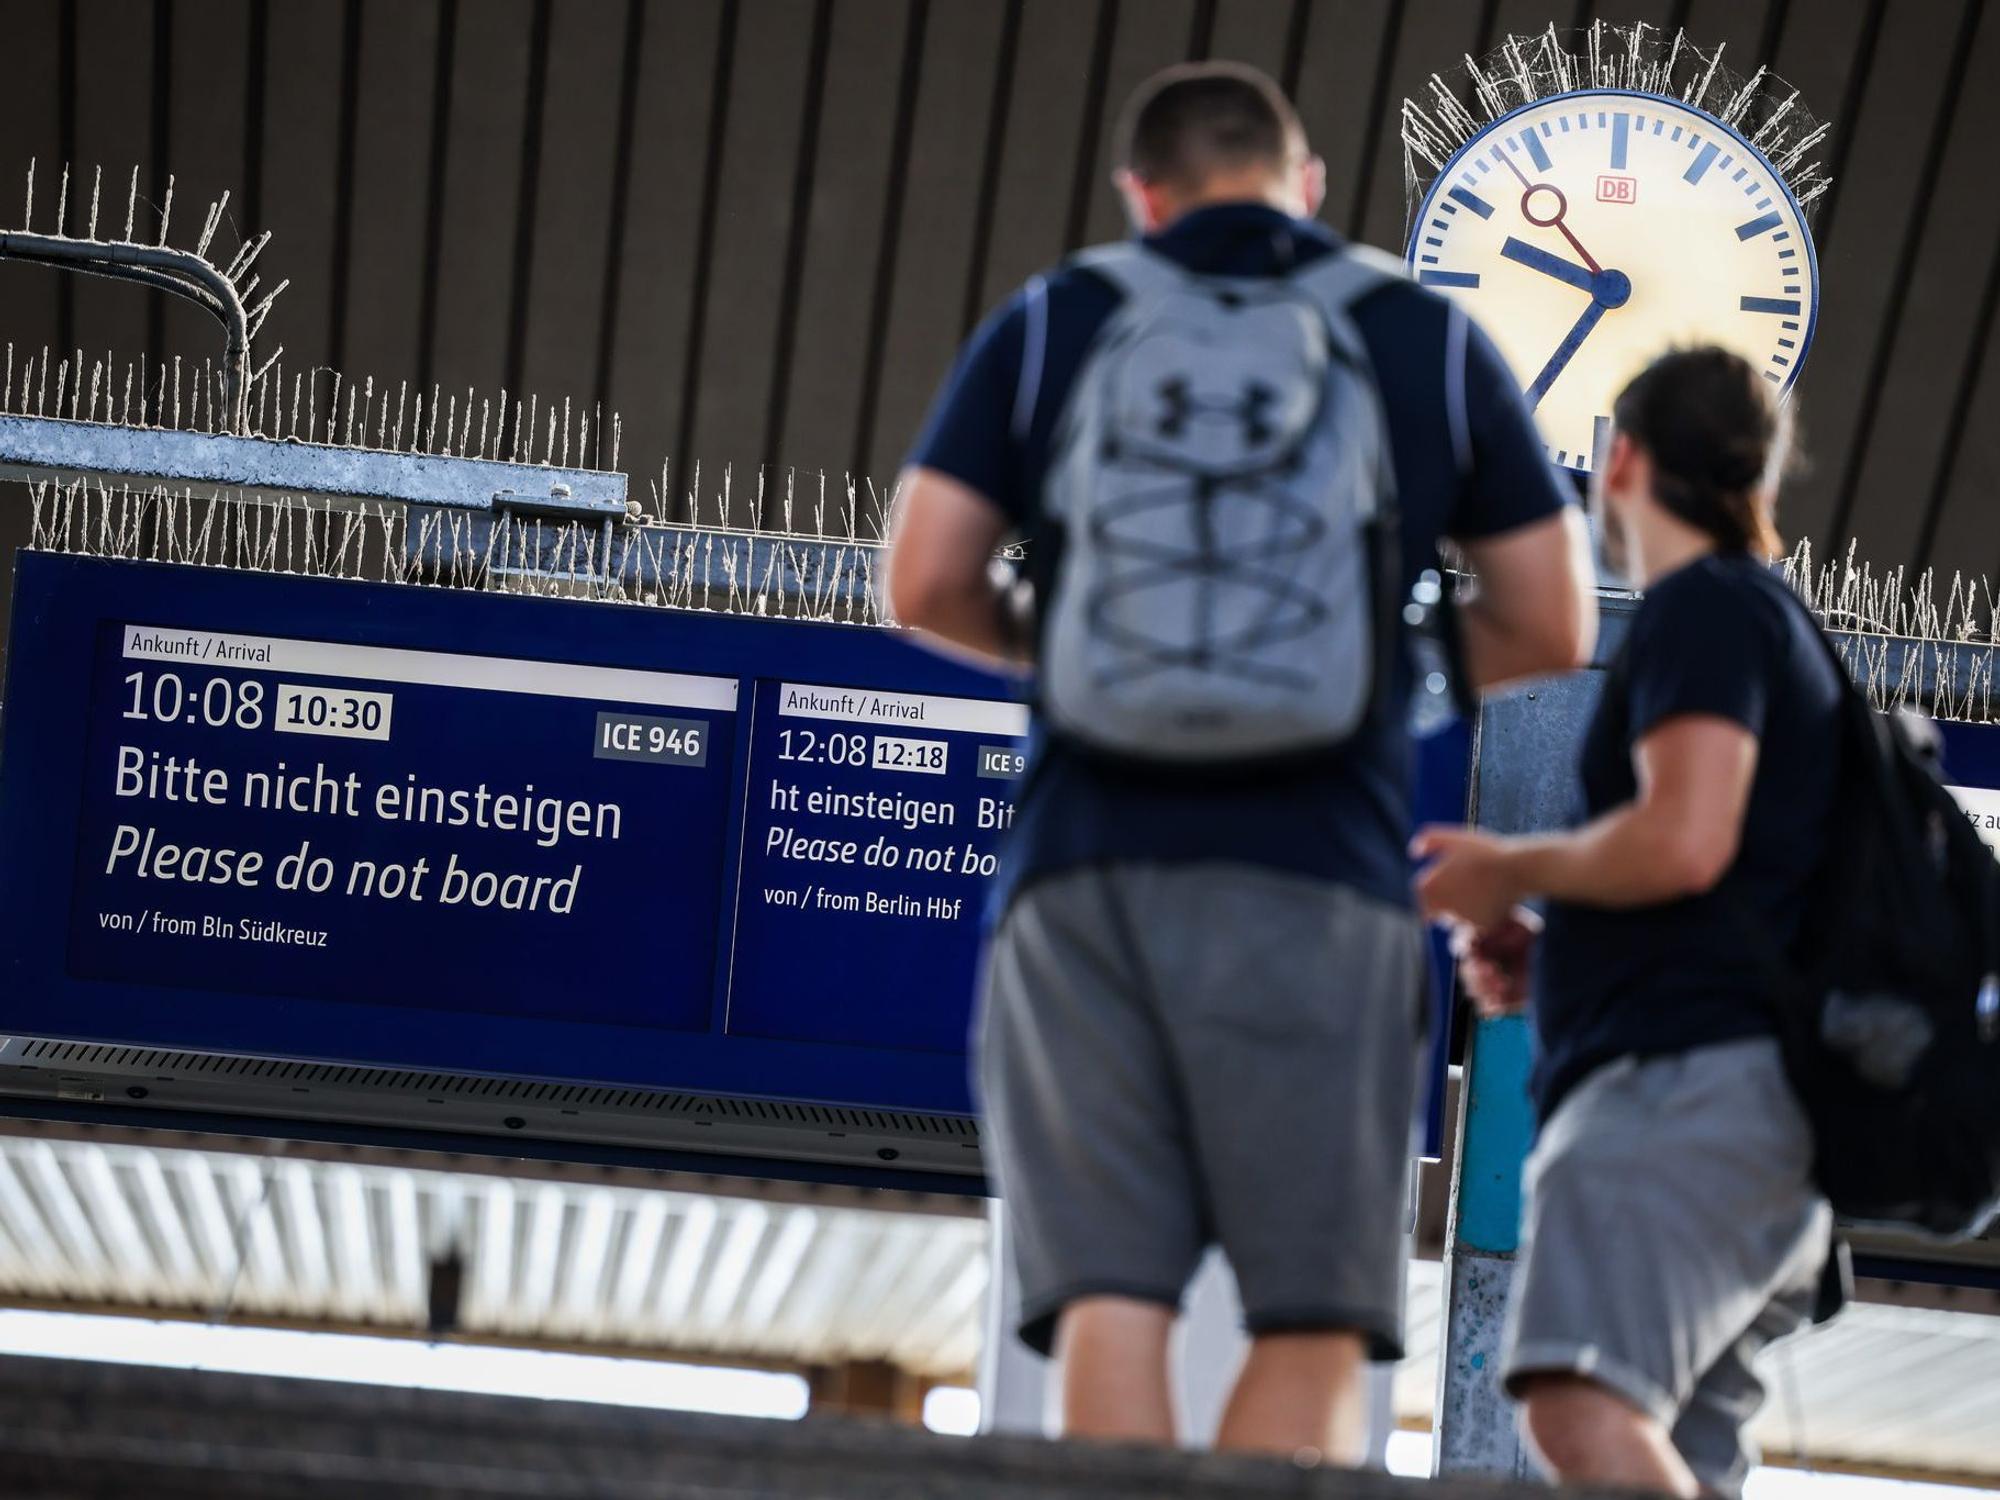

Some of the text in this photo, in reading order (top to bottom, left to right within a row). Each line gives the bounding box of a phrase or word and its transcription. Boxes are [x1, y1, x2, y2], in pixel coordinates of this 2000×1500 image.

[1603, 180, 1629, 199] DB
[131, 632, 271, 662] Ankunft / Arrival
[122, 671, 382, 731] 10:08 10:30
[787, 690, 925, 720] Ankunft / Arrival
[602, 722, 701, 756] ICE 946
[778, 729, 943, 769] 12:08 12:18
[985, 753, 1011, 772] ICE
[115, 745, 621, 847] Bitte nicht einsteigen
[770, 779, 800, 812] ht
[807, 786, 955, 830] einsteigen
[105, 824, 583, 914] Please do not board
[766, 826, 1001, 876] Please do not bo
[763, 885, 962, 921] von / from Berlin Hbf
[99, 909, 328, 947] von / from Bln Südkreuz
